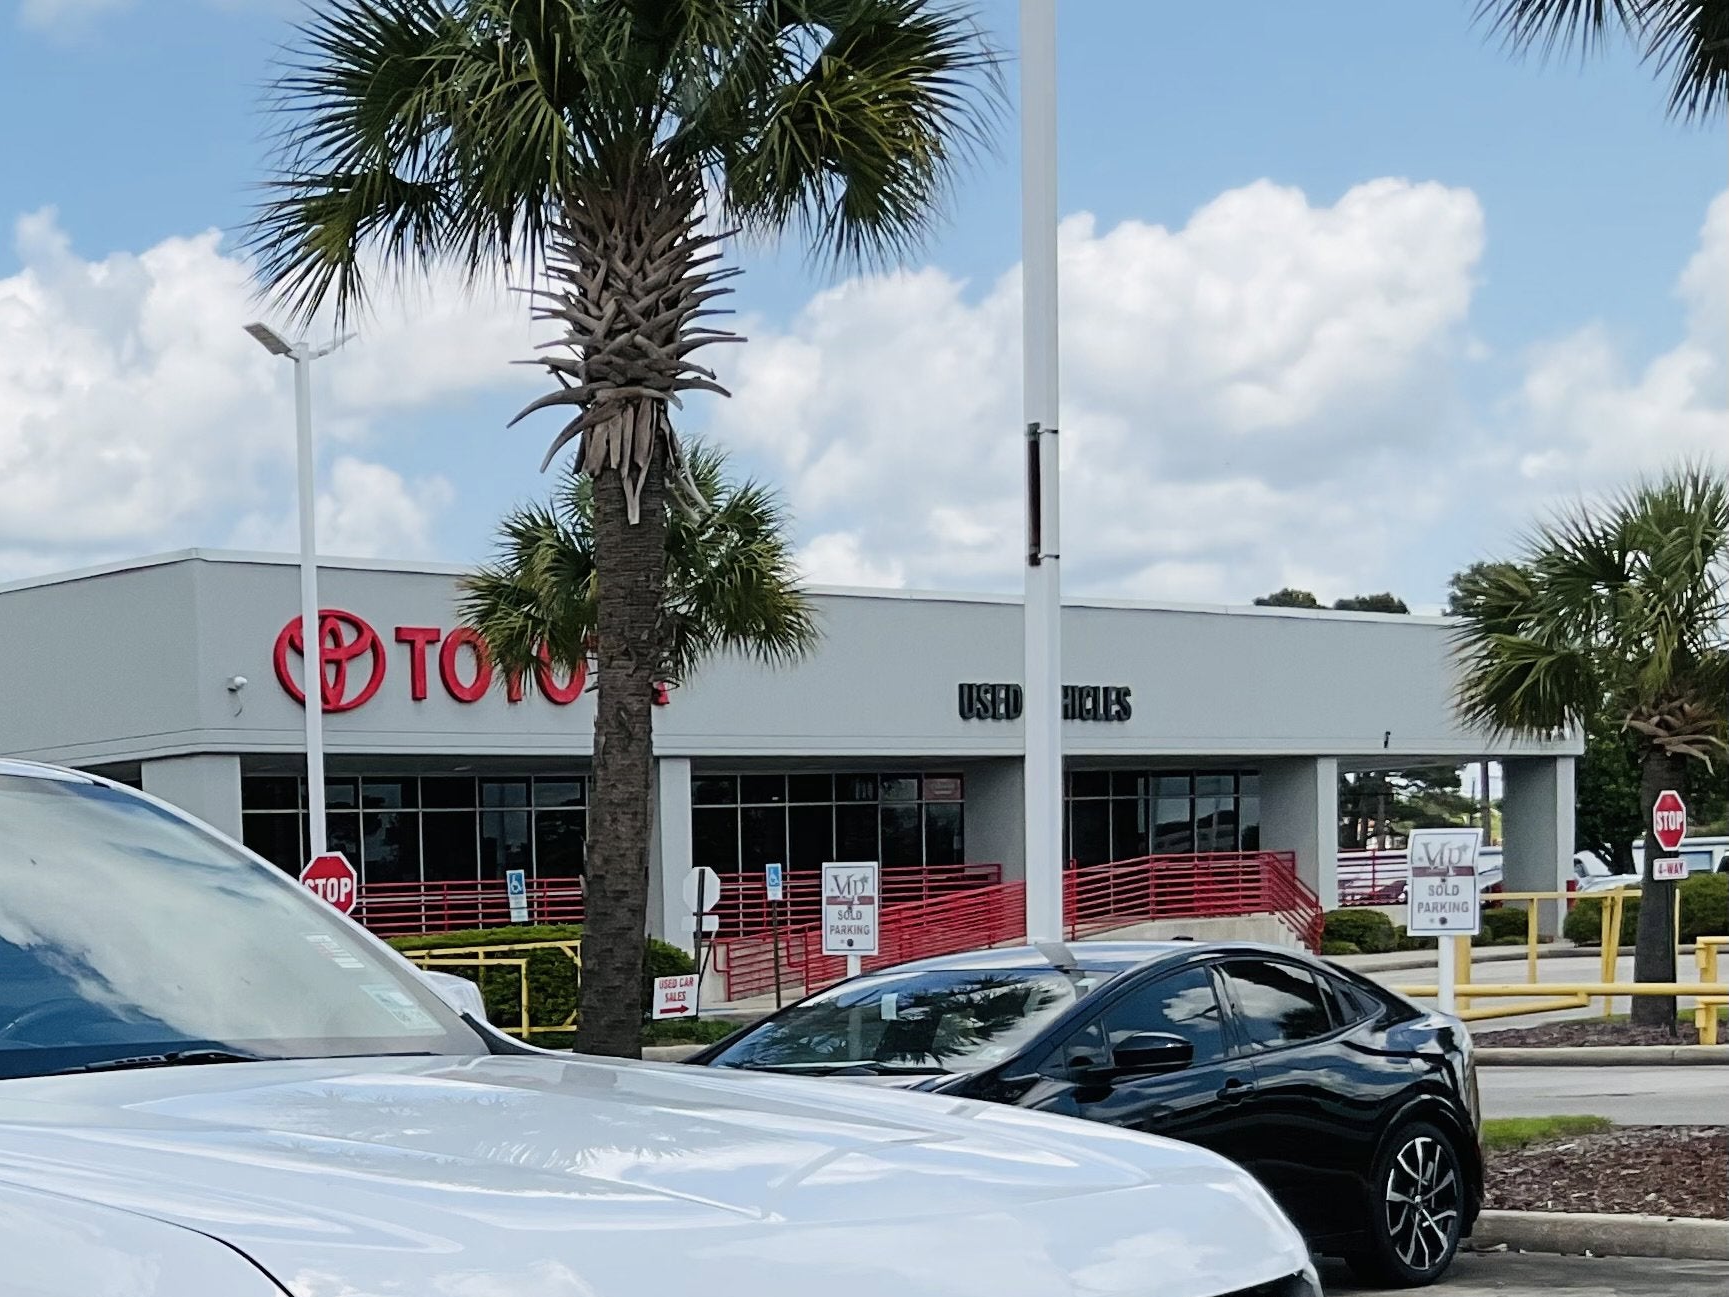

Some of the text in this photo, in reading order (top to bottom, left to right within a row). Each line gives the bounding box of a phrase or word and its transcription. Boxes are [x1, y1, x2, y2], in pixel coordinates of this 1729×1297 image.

[958, 683, 1132, 721] USED HICLES
[1656, 810, 1683, 831] STOP
[1658, 862, 1684, 876] 4-WAY
[1428, 884, 1460, 897] SOLD
[1417, 901, 1469, 914] PARKING
[837, 910, 862, 921] SOLD
[830, 925, 870, 936] PARKING
[659, 976, 694, 989] USED CAR
[665, 991, 686, 1003] SALES
